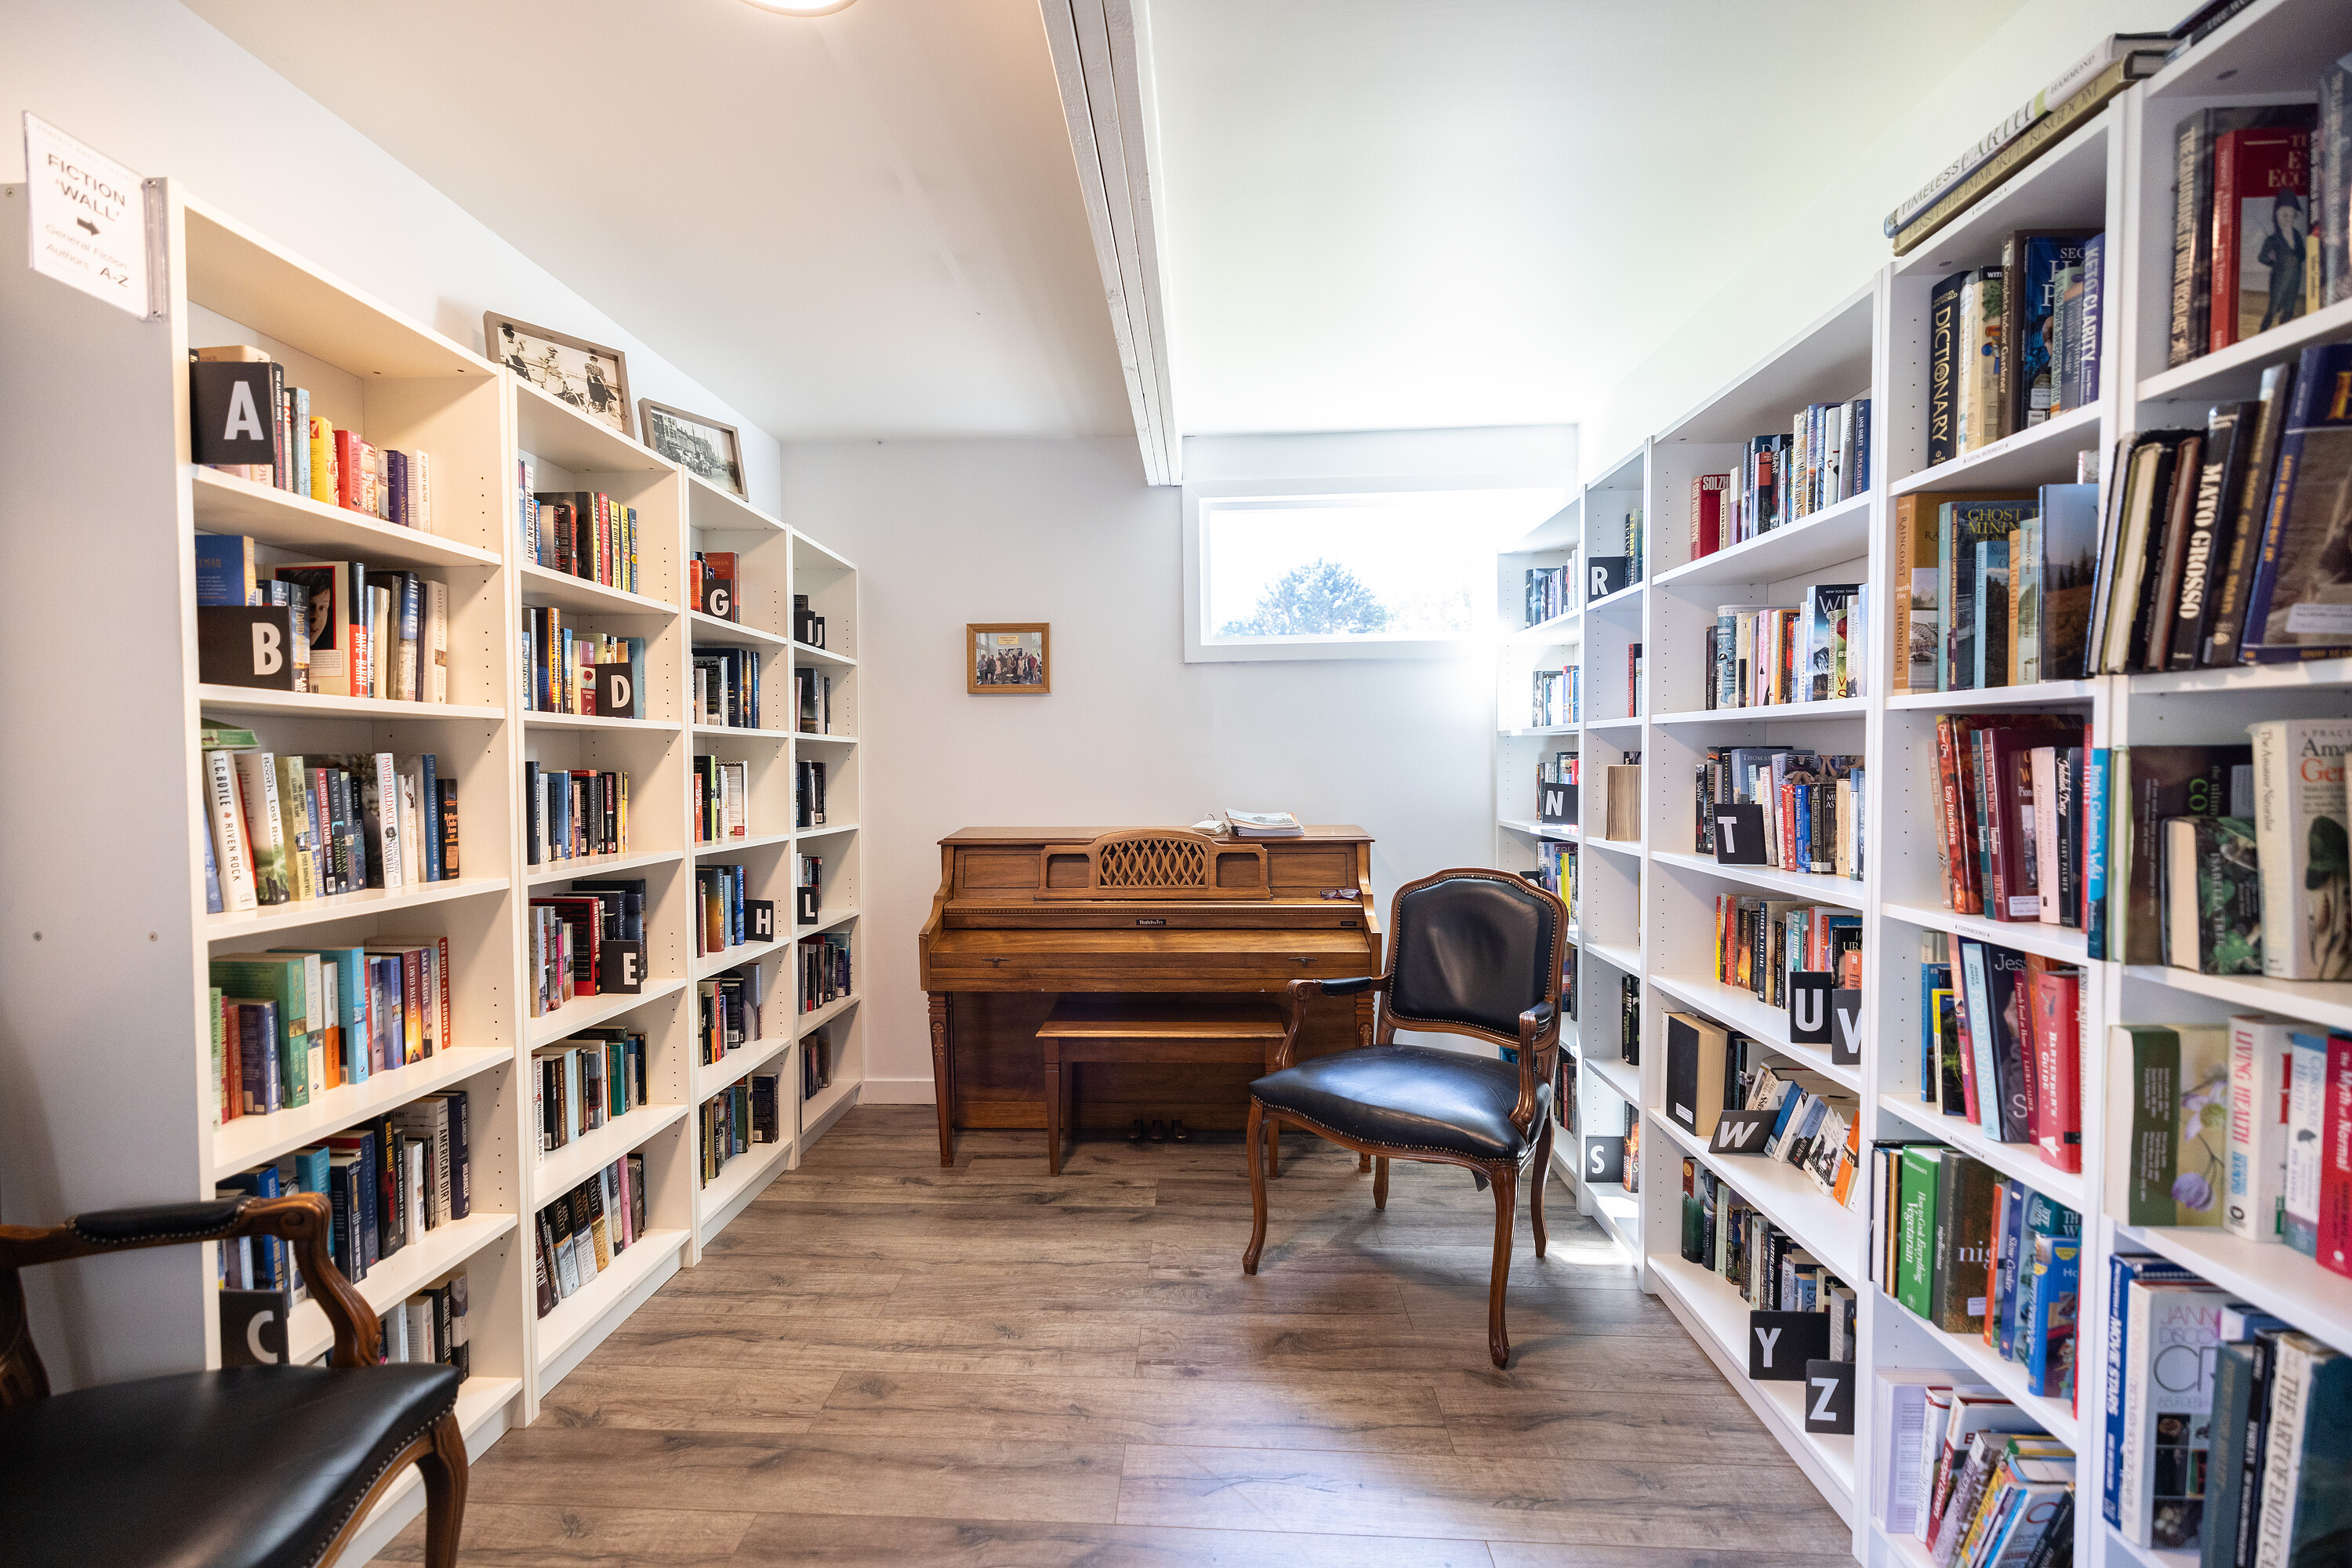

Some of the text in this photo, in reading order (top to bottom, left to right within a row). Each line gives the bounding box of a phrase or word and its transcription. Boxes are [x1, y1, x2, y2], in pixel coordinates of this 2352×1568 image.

[1900, 162, 1959, 216] TIMELESS
[1959, 100, 2031, 172] EARTH
[47, 154, 126, 206] FICTION
[45, 223, 91, 251] General
[2003, 241, 2012, 260] The
[100, 267, 129, 288] A-Z
[2000, 265, 2011, 311] Complete
[2054, 306, 2063, 329] More
[2081, 247, 2099, 361] KETO CLARITY
[1999, 347, 2008, 393] Gardener
[2053, 330, 2062, 372] Sleepless
[1932, 306, 1951, 442] DICTIONARY
[223, 381, 264, 441] A
[1968, 508, 2020, 521] GHOST
[1898, 517, 1907, 578] RAINCOAST
[1592, 566, 1609, 595] R
[2009, 557, 2020, 620] Victoria
[2179, 530, 2212, 619] GROSSO
[409, 603, 418, 633] BANKS
[710, 589, 729, 616] G
[252, 622, 282, 675] B
[355, 633, 367, 687] DAVE BARRY
[552, 686, 561, 704] WIN
[611, 675, 630, 708] D
[216, 776, 231, 806] BOYLE
[319, 780, 328, 806] LONDON
[382, 757, 394, 825] DAVID BALDACCI
[1545, 790, 1564, 816] N
[321, 808, 331, 845] BOULEVARD
[1717, 816, 1737, 853] T
[1944, 786, 1958, 845] Easy Entertaining
[2089, 800, 2102, 850] Columbia
[225, 823, 237, 851] RIVEN
[271, 826, 281, 855] River
[1977, 826, 1987, 851] Humphreys
[1990, 826, 1999, 855] Humphreys
[230, 856, 241, 883] ROCK
[385, 842, 394, 874] MAXWELL
[756, 909, 771, 935] H
[805, 894, 815, 917] L
[1793, 914, 1799, 923] DO
[1958, 924, 1986, 938] COOKBOOKS
[623, 953, 637, 985] E
[1795, 989, 1824, 1032] U
[1837, 1008, 1862, 1054] V
[1970, 989, 1994, 1105] FOOD SWINGS
[2232, 1029, 2253, 1145] LIVING HEALTH
[1718, 1122, 1759, 1148] W
[2336, 1119, 2351, 1173] Normal
[438, 1128, 449, 1205] AMERICAN DIRT
[1590, 1145, 1605, 1174] S
[1904, 1201, 1918, 1262] Vegetarian
[1936, 1225, 1945, 1270] nigellissima
[1914, 1236, 1926, 1284] Everything
[2005, 1234, 2017, 1293] Slow Cooker
[247, 1310, 278, 1364] C
[1755, 1327, 1782, 1367] Y
[1809, 1377, 1839, 1421] Z
[2107, 1367, 2120, 1416] STARS
